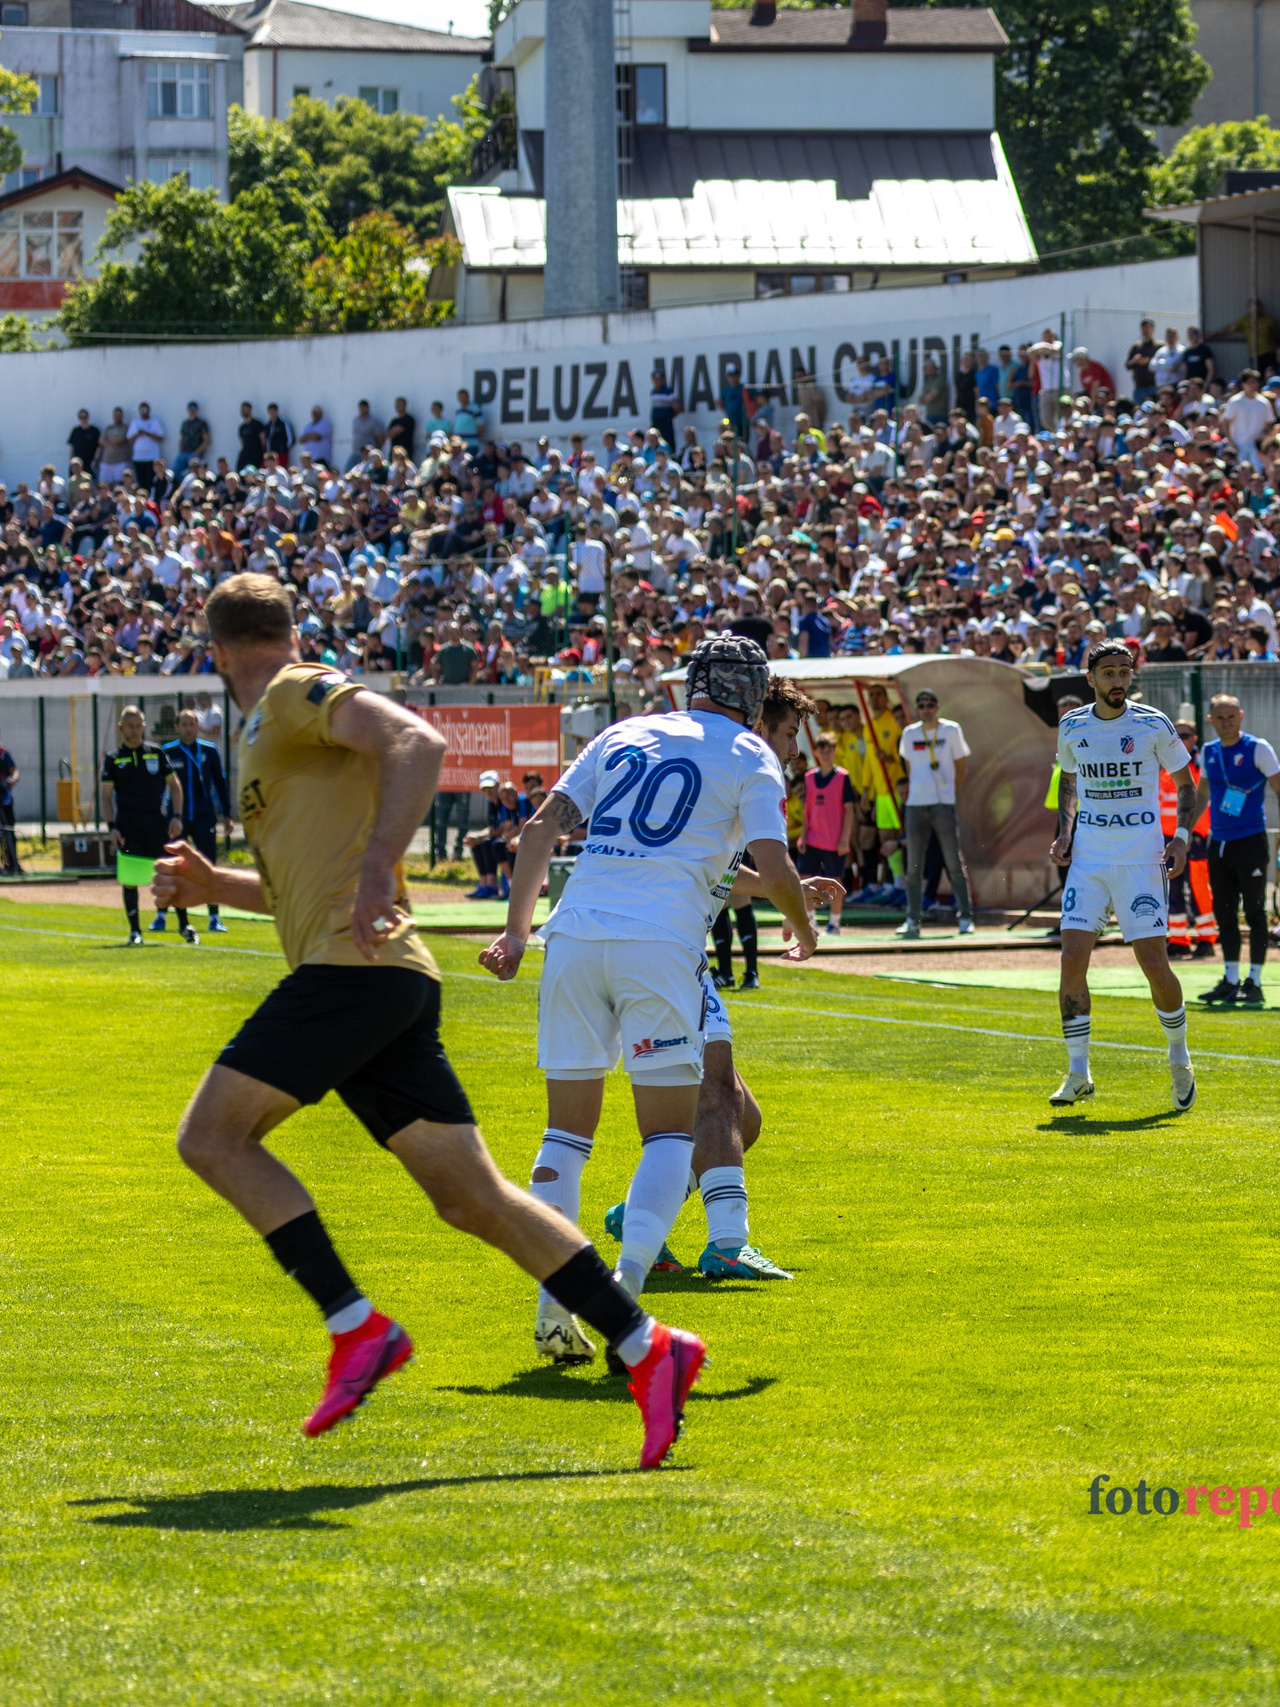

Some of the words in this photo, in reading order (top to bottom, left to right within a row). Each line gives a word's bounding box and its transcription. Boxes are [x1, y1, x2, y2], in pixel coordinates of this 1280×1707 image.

[474, 360, 639, 424] PELUZA
[1078, 761, 1143, 779] UNIBET
[590, 745, 702, 847] 20
[1079, 811, 1156, 827] ELSACO
[1064, 887, 1076, 912] 8
[653, 1035, 688, 1049] Smart
